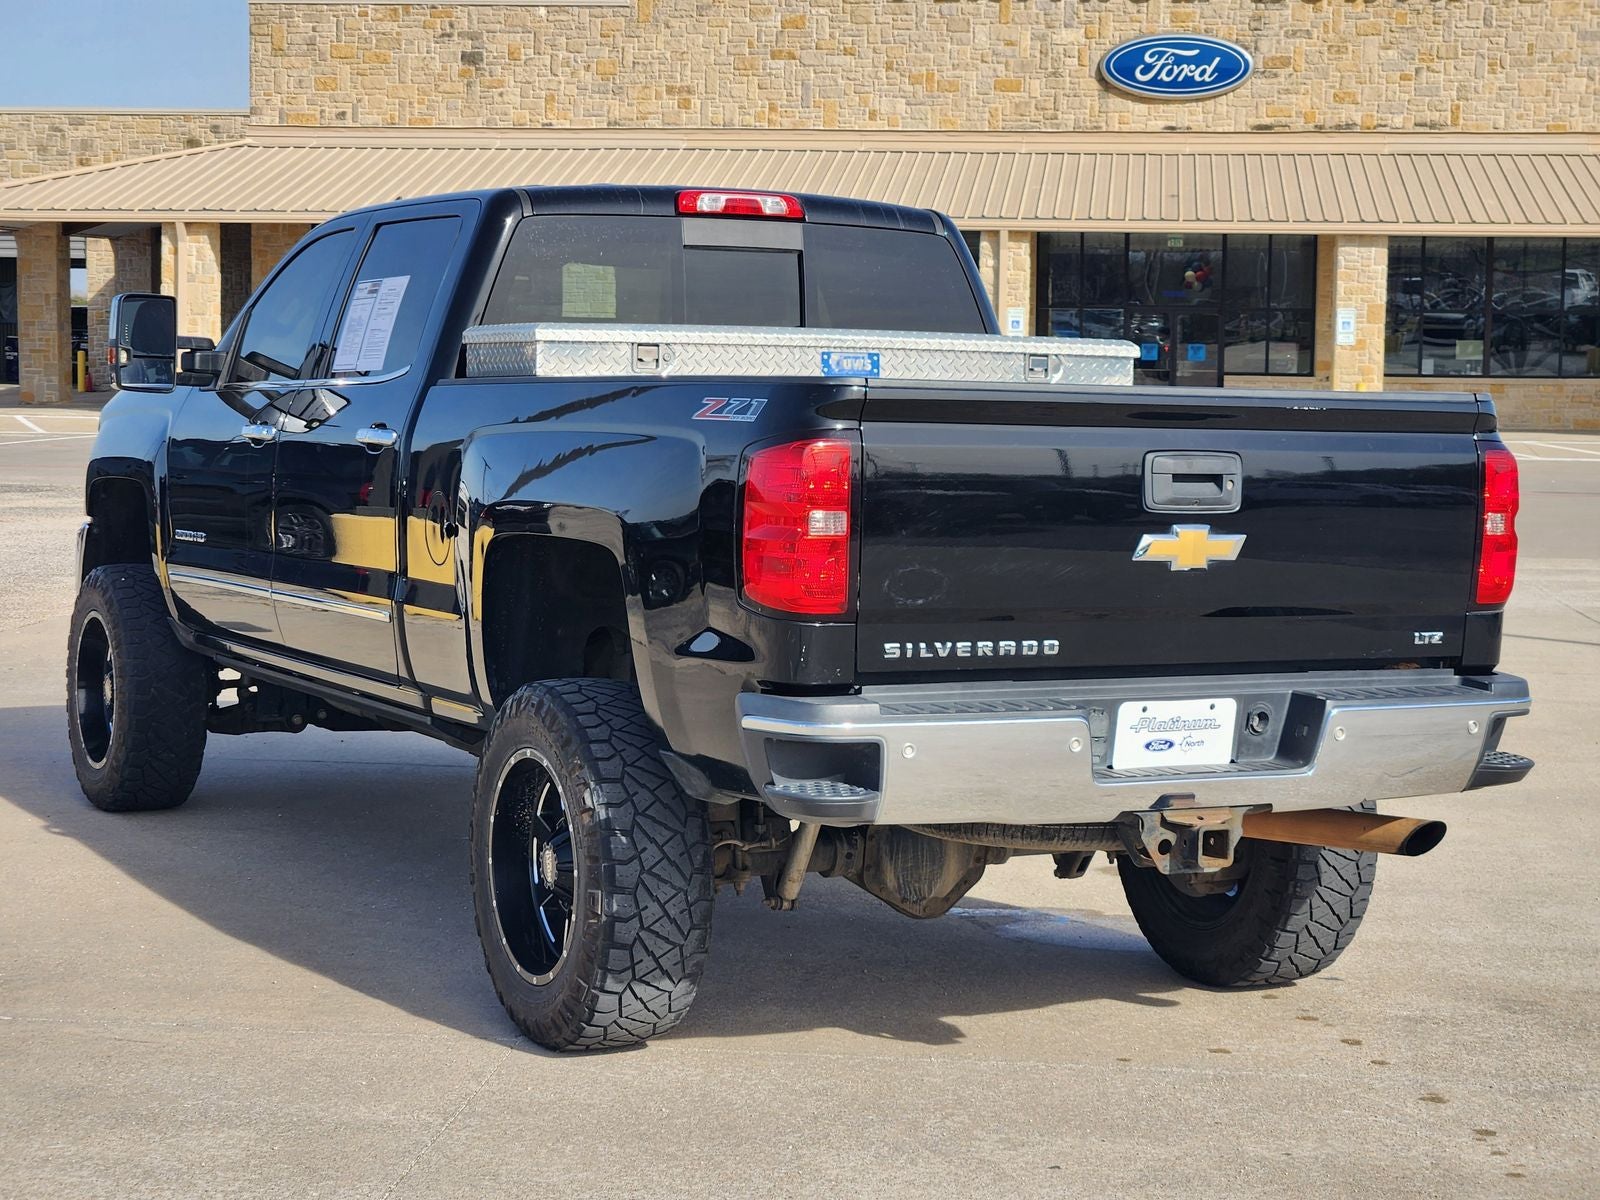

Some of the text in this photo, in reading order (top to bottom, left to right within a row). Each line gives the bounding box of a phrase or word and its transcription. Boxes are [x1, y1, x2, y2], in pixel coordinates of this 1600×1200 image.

[1134, 47, 1221, 83] Ford
[691, 397, 768, 422] Z71
[1414, 631, 1444, 645] LTZ
[883, 640, 1060, 659] SILVERADO
[1130, 716, 1221, 733] Platinum
[1148, 740, 1172, 751] Ford
[1184, 739, 1205, 749] North
